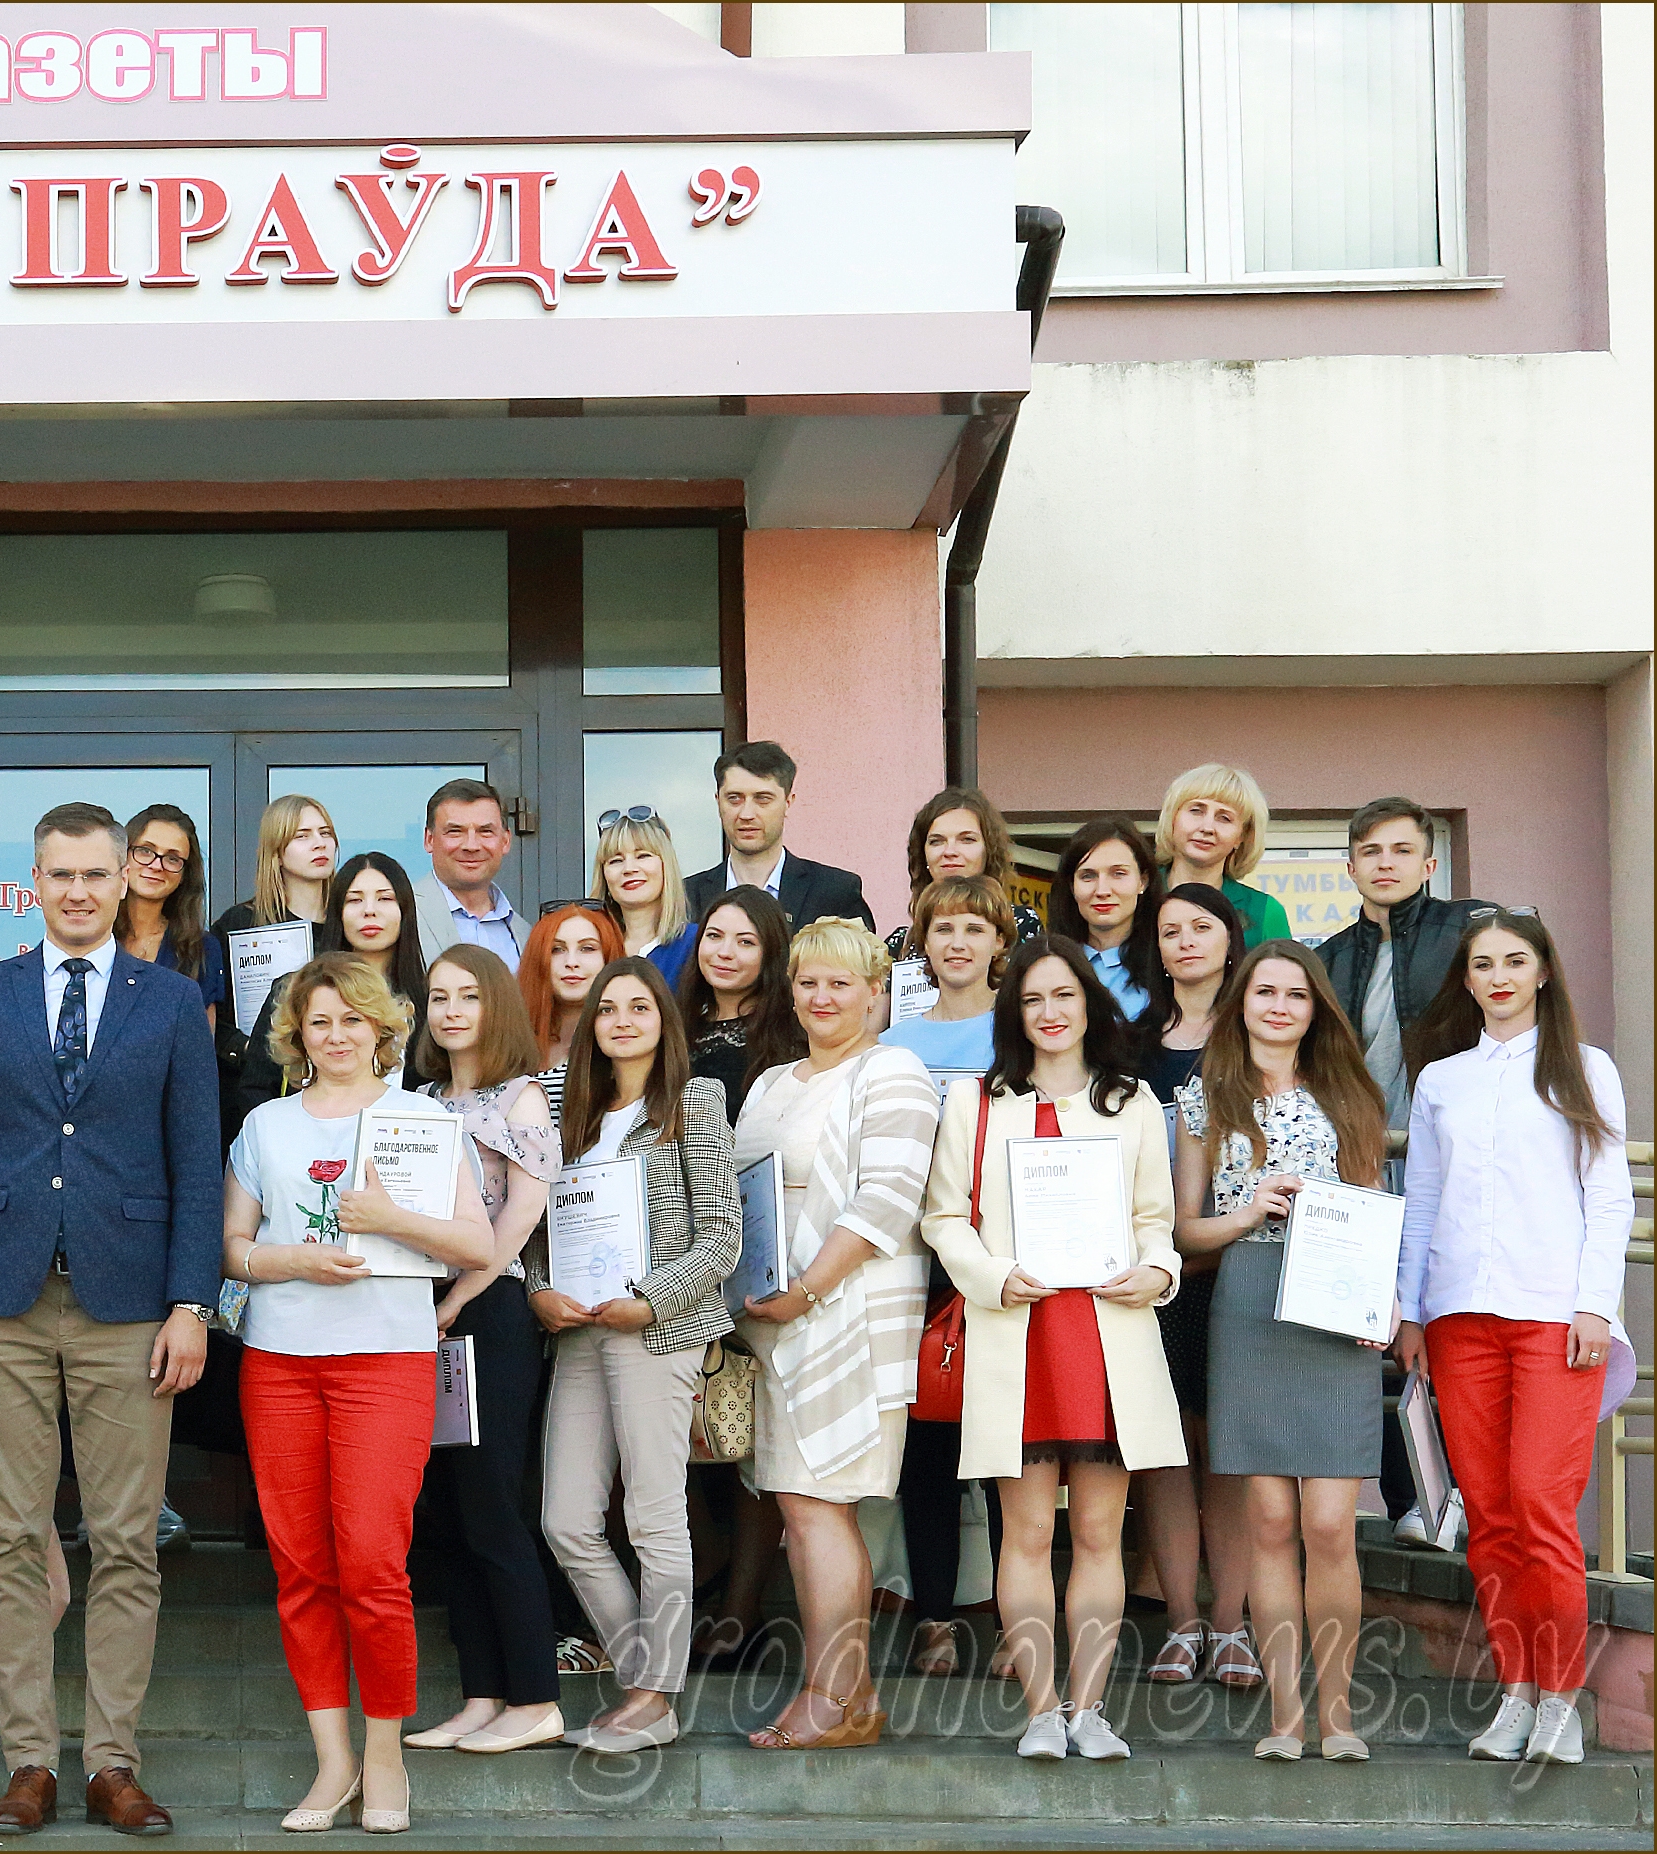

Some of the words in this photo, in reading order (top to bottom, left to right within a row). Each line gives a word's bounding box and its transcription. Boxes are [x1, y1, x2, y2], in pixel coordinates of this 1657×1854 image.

[239, 954, 272, 969] ДИПЛОМ
[373, 1142, 439, 1155] БЛАГОДАРСТВЕННОЕ
[373, 1155, 400, 1166] ПИСЬМО
[1023, 1165, 1068, 1180] ДИПЛОМ
[555, 1190, 594, 1209] ДИПЛОМ
[1305, 1204, 1349, 1224] ДИПЛОМ
[441, 1349, 453, 1394] ДИПЛОМ
